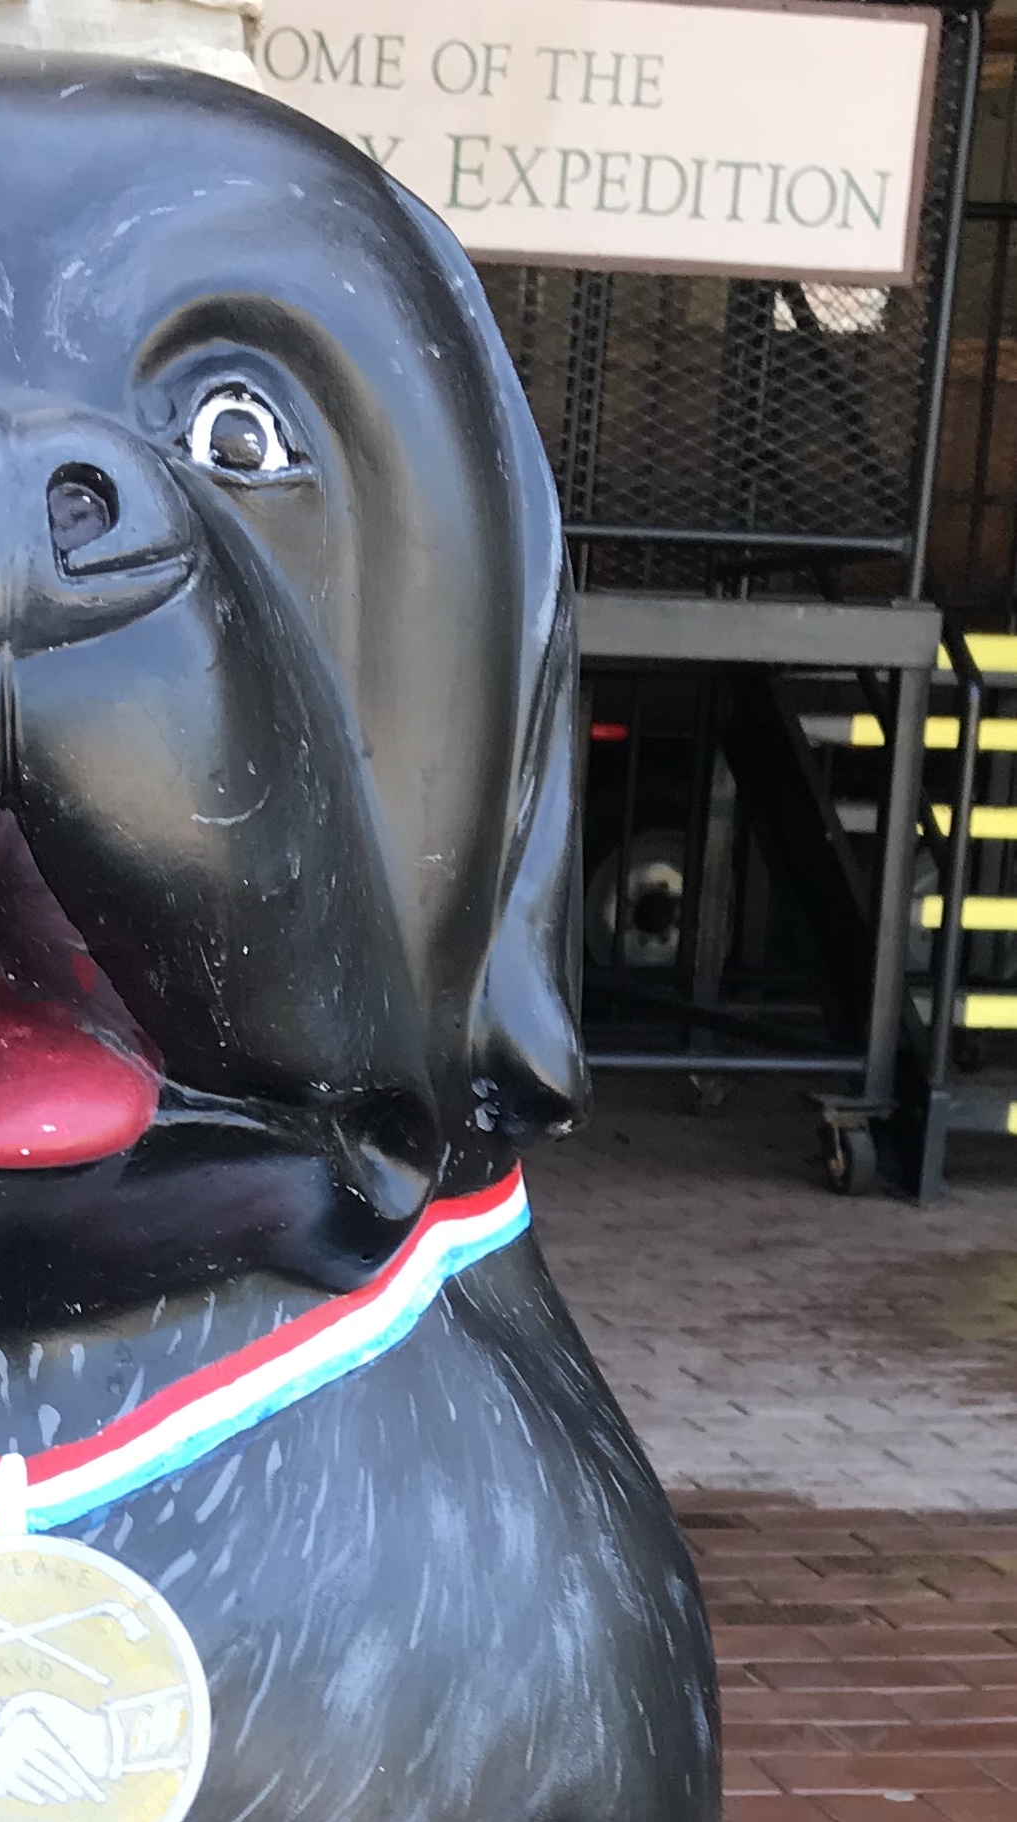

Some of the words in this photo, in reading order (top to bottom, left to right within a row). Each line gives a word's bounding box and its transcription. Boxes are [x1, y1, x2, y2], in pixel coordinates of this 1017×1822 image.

[250, 25, 406, 90] OME
[432, 39, 512, 97] OF
[535, 46, 665, 109] THE
[444, 133, 893, 230] EXPEDITION
